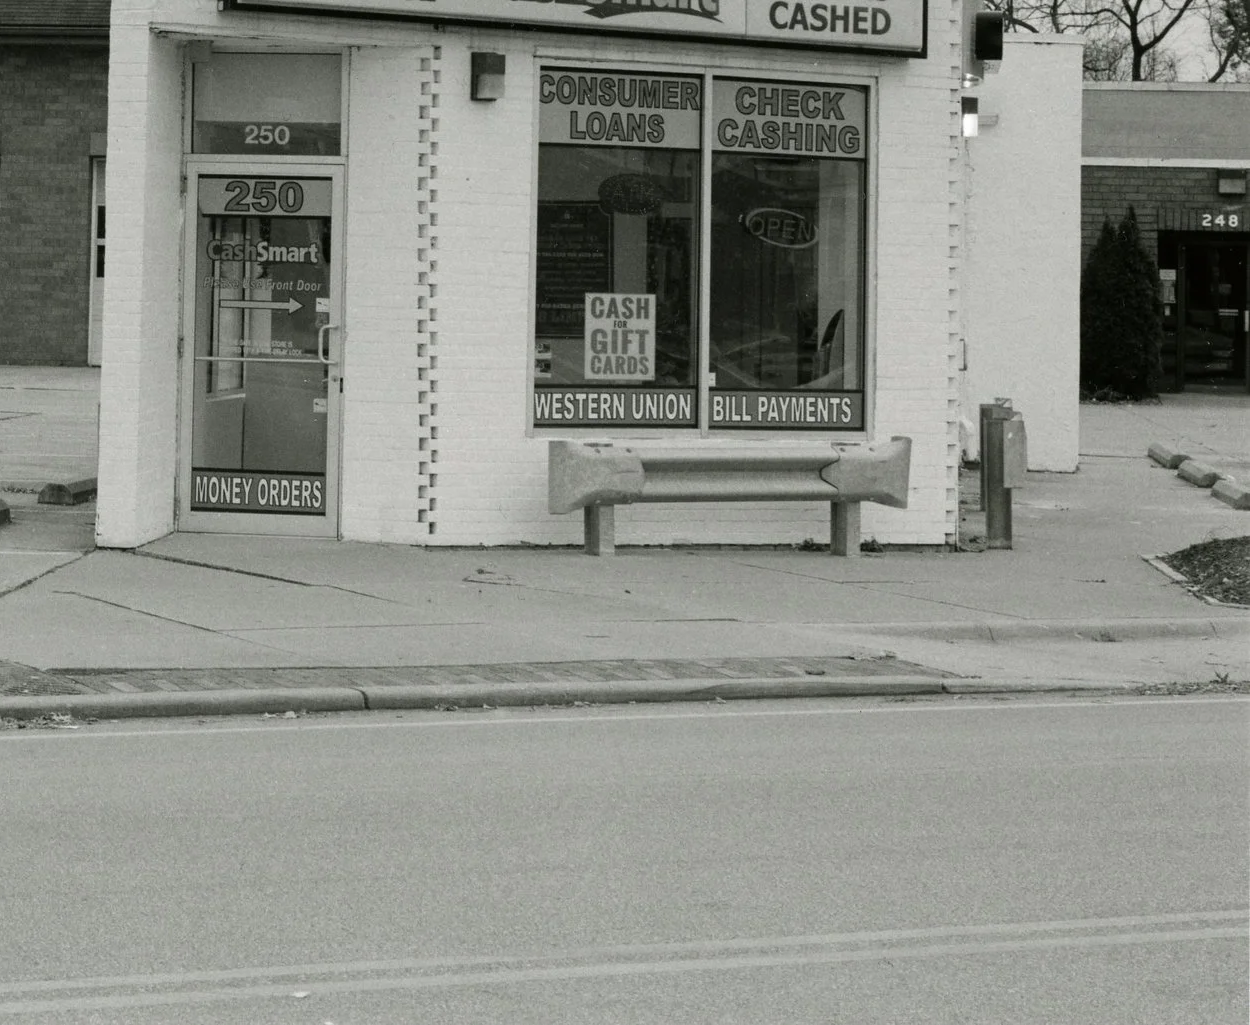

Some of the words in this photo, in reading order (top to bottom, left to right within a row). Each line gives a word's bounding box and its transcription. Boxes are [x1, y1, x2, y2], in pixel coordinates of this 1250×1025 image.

[769, 0, 892, 36] CASHED
[539, 74, 700, 111] CONSUMER
[735, 86, 846, 120] CHECK
[244, 125, 291, 145] 250
[569, 111, 665, 143] LOANS
[717, 119, 860, 154] CASHING
[224, 180, 304, 213] 250
[748, 215, 812, 241] OPEN
[1202, 214, 1239, 227] 248
[207, 239, 319, 263] CashSmart
[266, 278, 293, 291] Front
[296, 279, 322, 292] Door
[591, 296, 650, 319] CASH
[613, 320, 628, 328] FOR
[591, 328, 650, 355] GIFT
[591, 355, 650, 375] CARDS
[534, 393, 626, 419] WESTERN
[631, 393, 692, 420] UNION
[713, 395, 752, 422] BILL
[757, 396, 851, 423] PAYMENTS
[195, 476, 253, 505] MONEY
[257, 478, 322, 508] ORDERS
